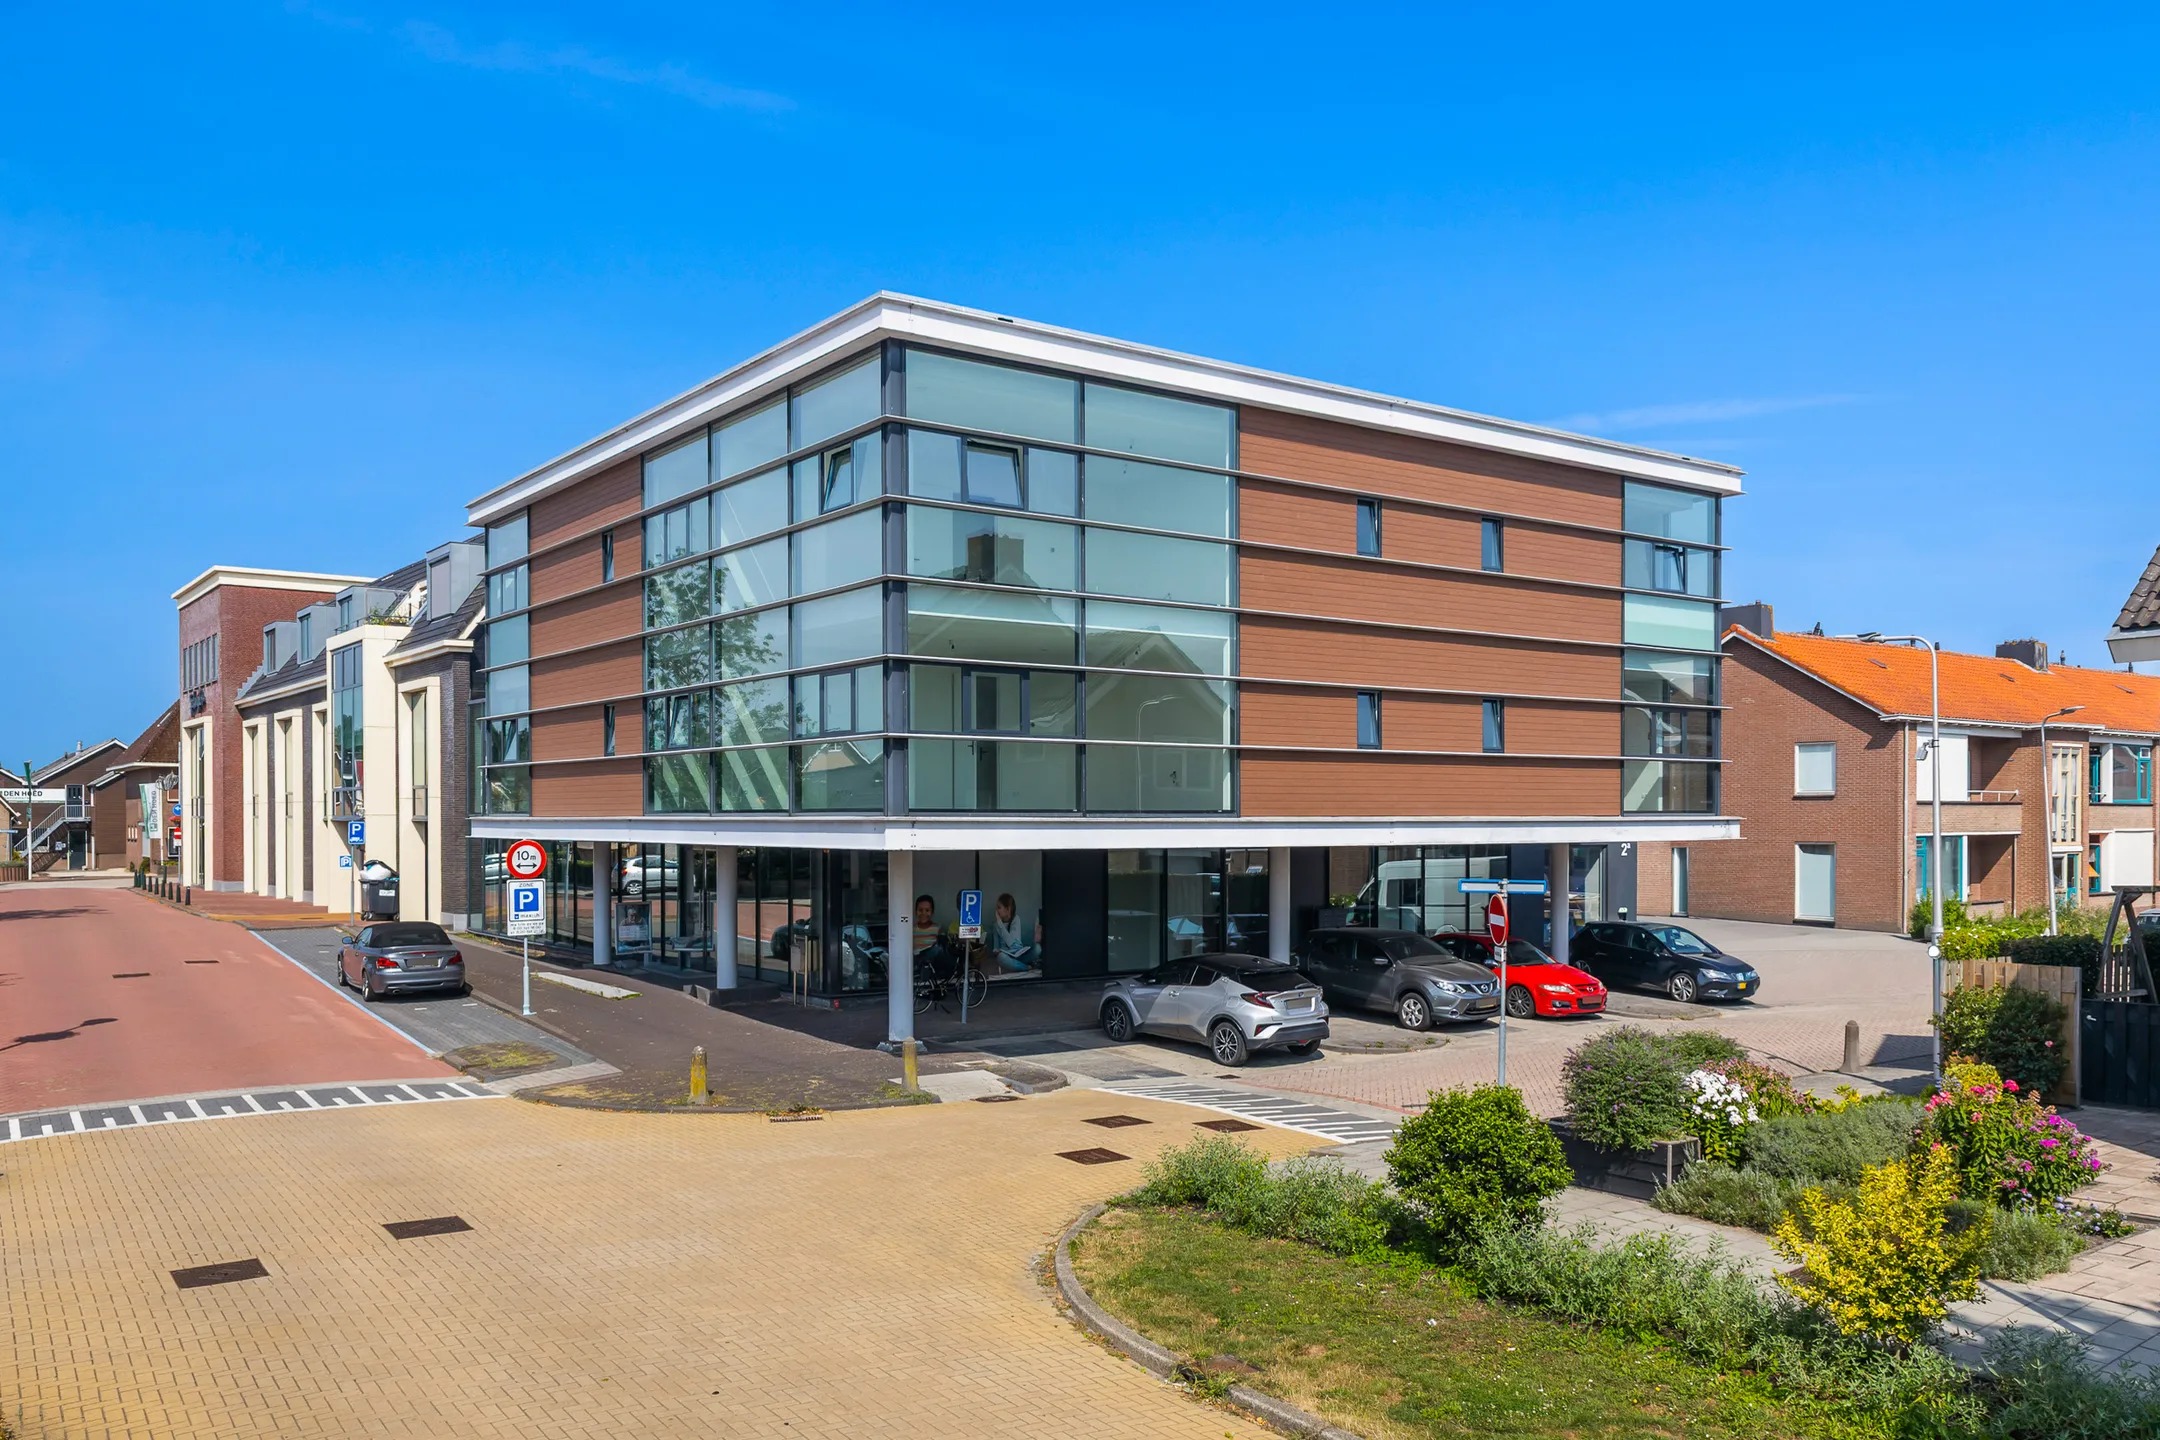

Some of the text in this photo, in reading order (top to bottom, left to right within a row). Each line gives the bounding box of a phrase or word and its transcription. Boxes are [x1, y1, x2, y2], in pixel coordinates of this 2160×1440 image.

[352, 824, 361, 835] P
[343, 858, 349, 867] P
[520, 891, 534, 909] P
[966, 894, 977, 911] P
